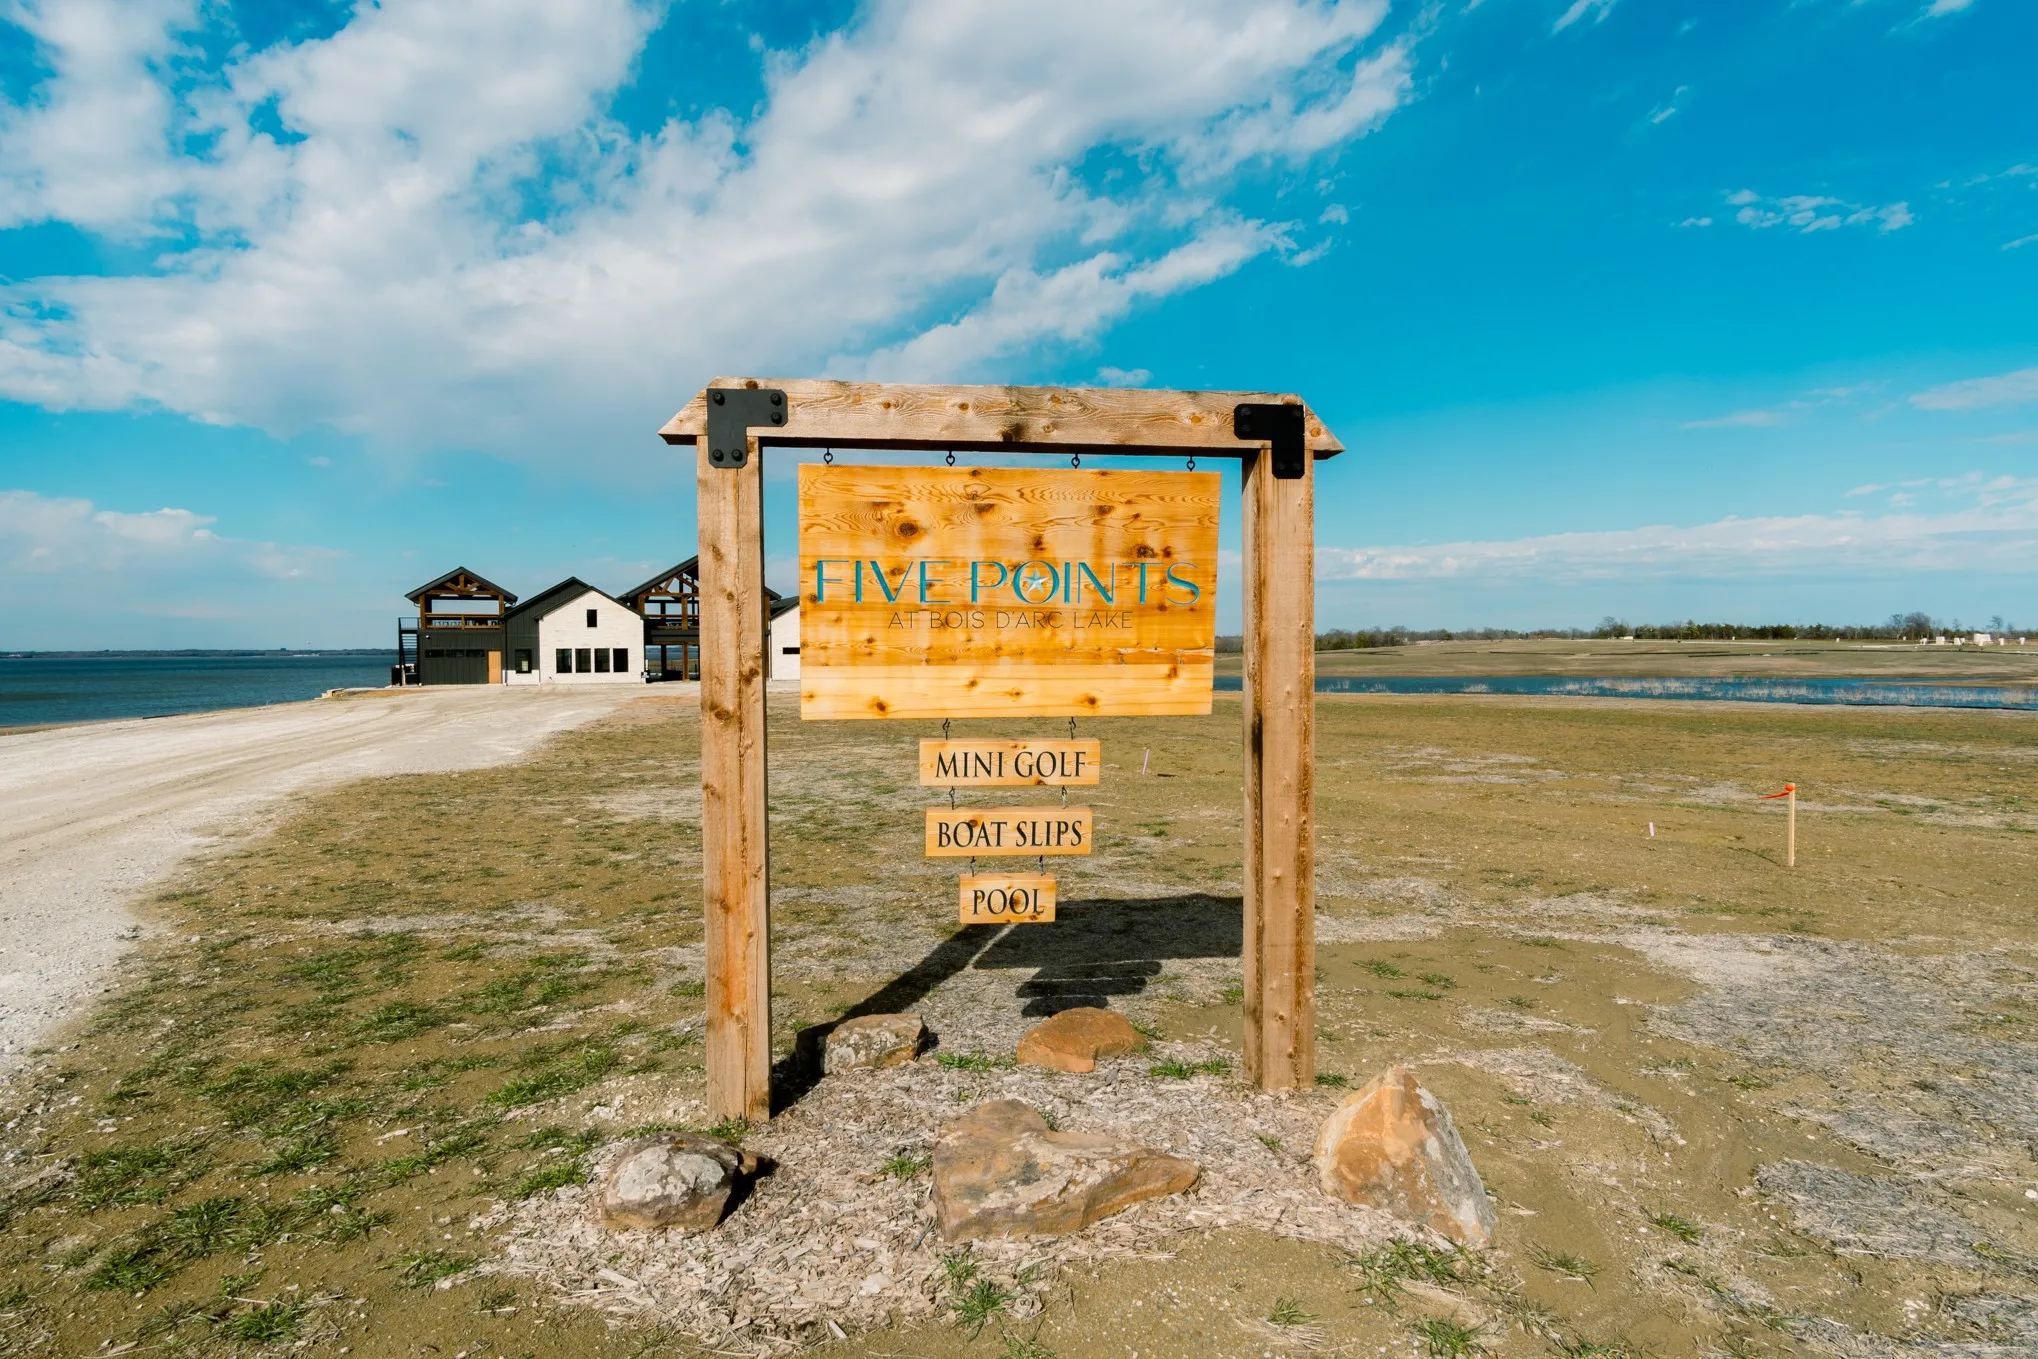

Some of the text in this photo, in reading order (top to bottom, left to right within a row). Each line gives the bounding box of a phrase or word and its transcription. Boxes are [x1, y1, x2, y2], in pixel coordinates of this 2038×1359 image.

[816, 559, 1201, 605] FIVE POINTS
[888, 611, 1134, 630] AT BOIS D'ARC LAKE
[935, 751, 1087, 778] MINI GOLF
[937, 820, 1083, 848] BOAT SLIPS
[972, 888, 1045, 916] POOL
